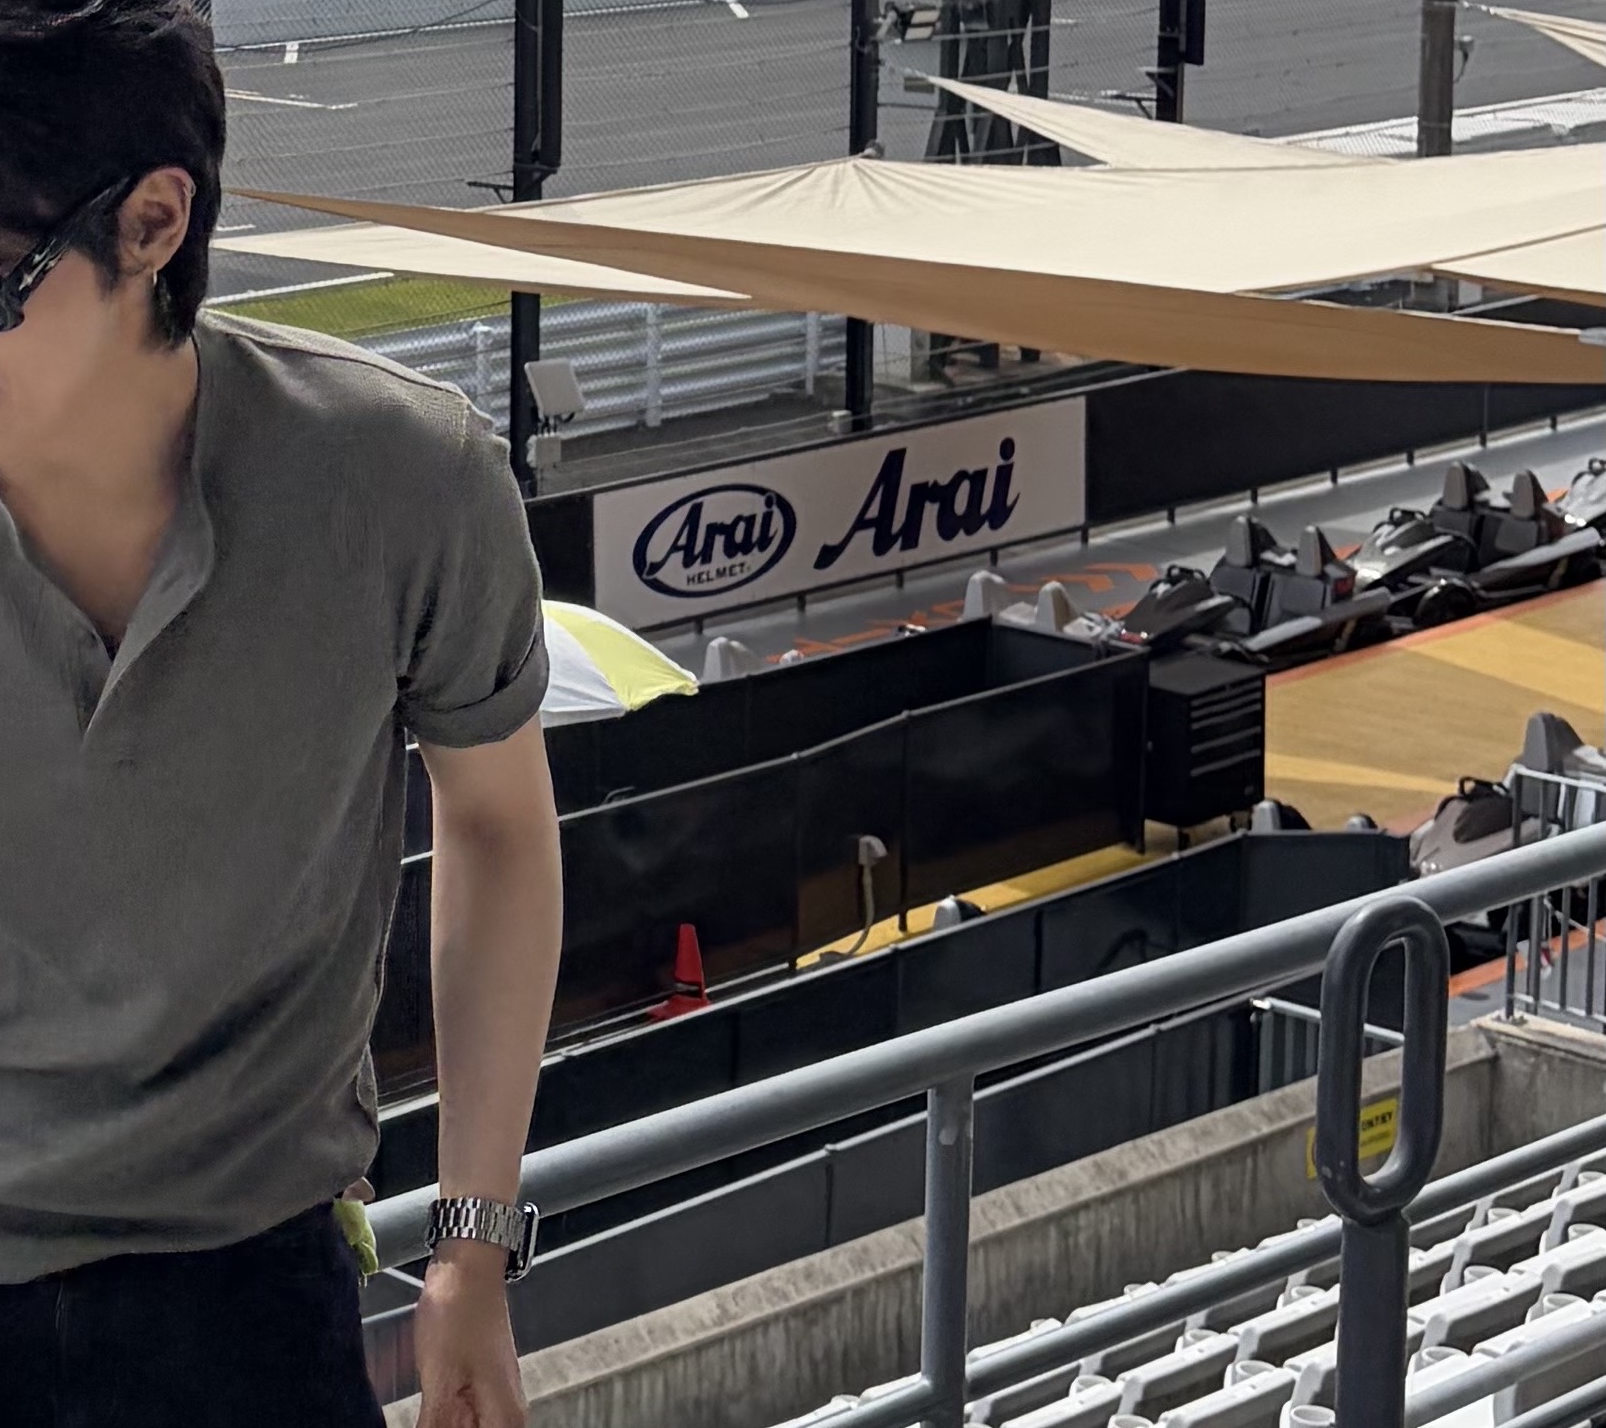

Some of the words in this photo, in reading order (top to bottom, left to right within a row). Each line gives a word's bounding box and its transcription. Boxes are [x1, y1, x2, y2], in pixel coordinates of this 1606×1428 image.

[646, 492, 778, 576] Arai
[813, 437, 1020, 570] Arai
[686, 563, 746, 586] HELMET
